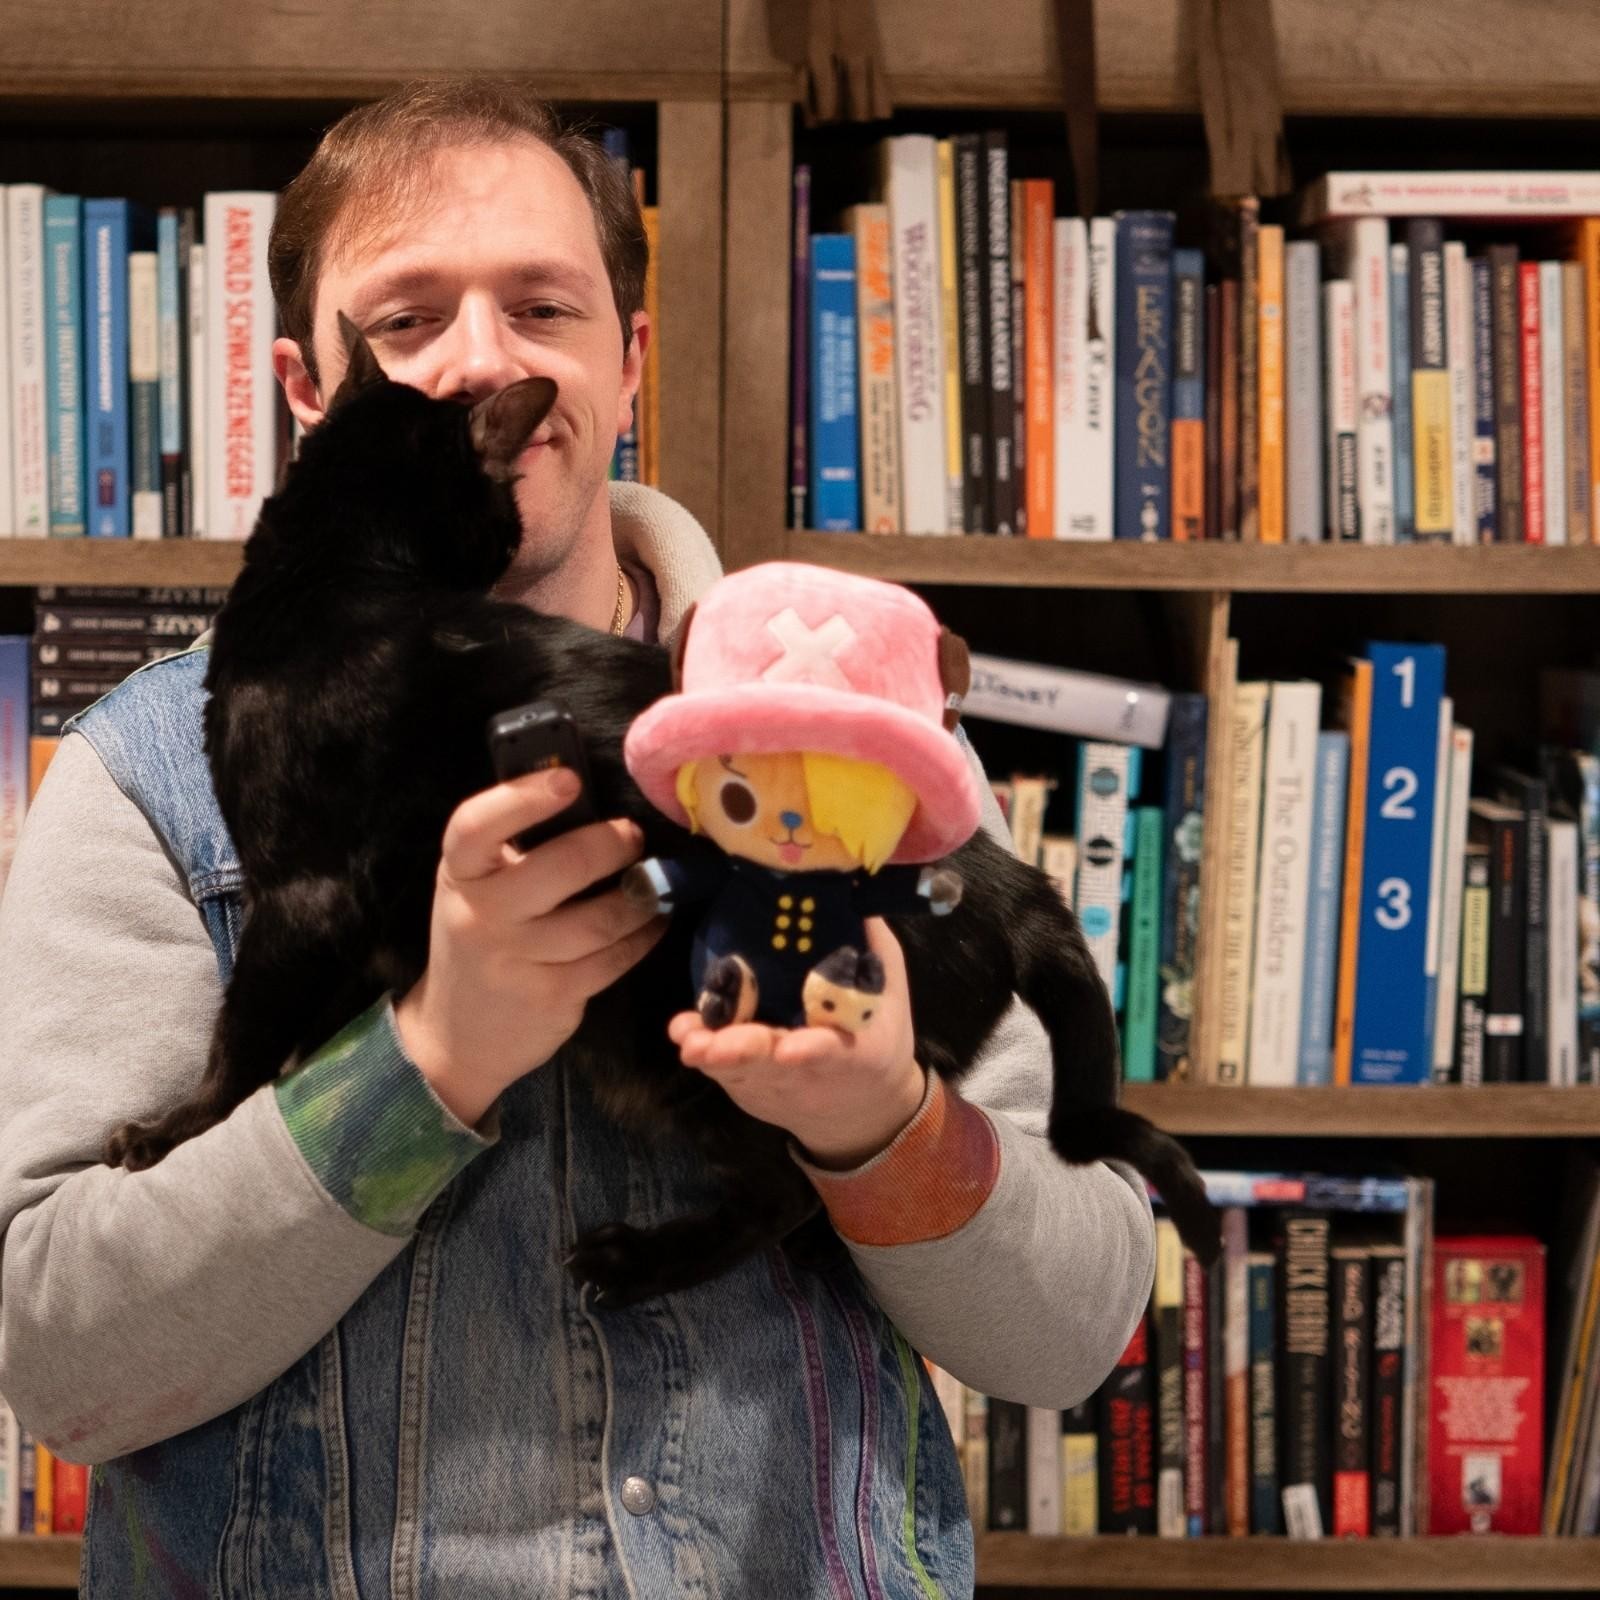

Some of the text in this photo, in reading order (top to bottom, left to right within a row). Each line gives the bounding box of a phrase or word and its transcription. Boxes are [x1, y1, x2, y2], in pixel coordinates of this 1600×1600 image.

[226, 207, 254, 498] ARNOLD SCHWARZENEGGER
[1135, 285, 1170, 468] ERAGON
[1263, 772, 1304, 979] The Outsiders
[1374, 656, 1418, 931] 1 2 3
[1286, 1218, 1329, 1356] CHUCK BERRY
